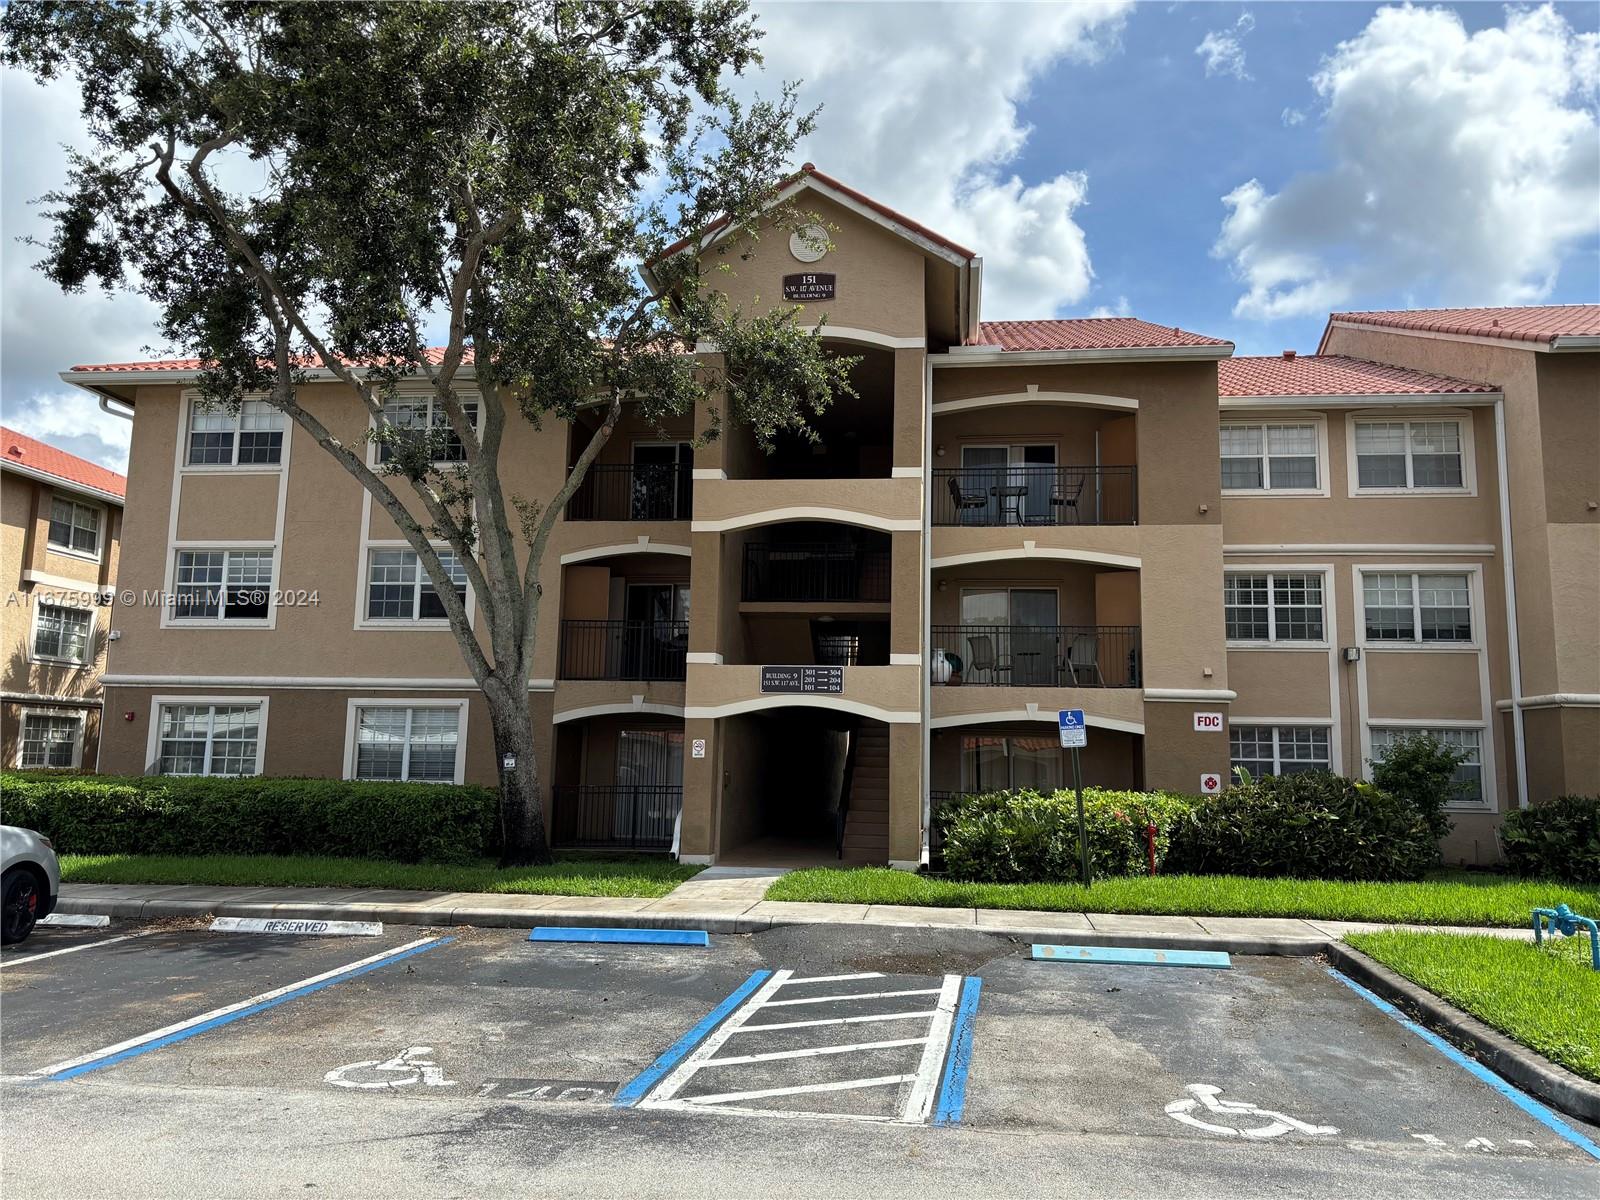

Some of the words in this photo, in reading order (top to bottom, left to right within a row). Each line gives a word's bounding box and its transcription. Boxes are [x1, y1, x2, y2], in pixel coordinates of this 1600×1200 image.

[802, 275, 816, 284] 151
[808, 284, 833, 292] AVENUE
[1197, 716, 1219, 727] FDC
[263, 921, 329, 932] RESERVED
